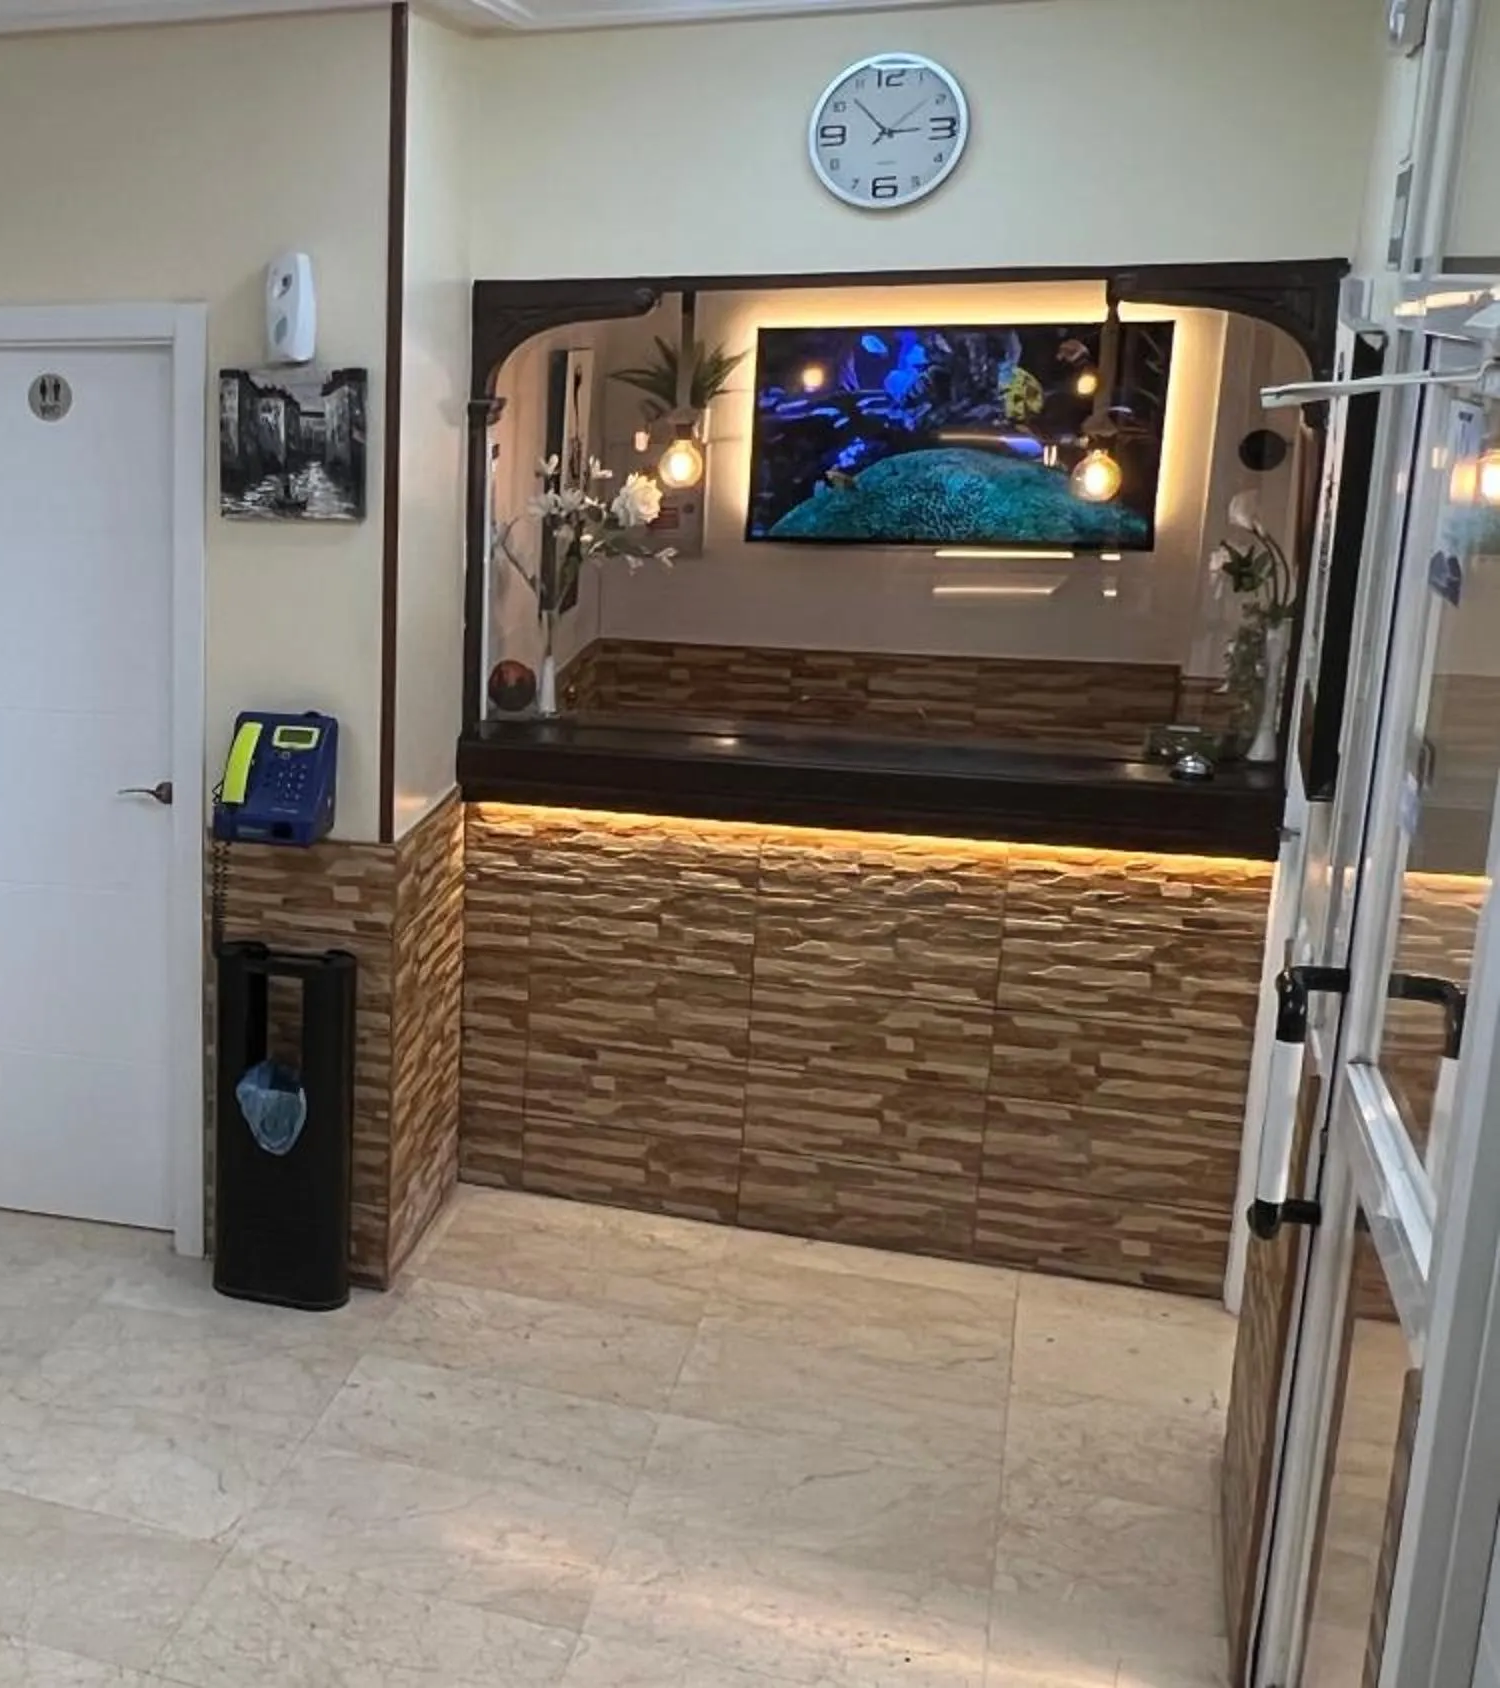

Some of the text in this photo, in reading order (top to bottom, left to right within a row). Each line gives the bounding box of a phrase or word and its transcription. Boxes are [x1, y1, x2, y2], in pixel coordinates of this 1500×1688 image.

[876, 69, 906, 88] 12
[819, 125, 846, 147] 9
[928, 117, 957, 140] 3
[871, 175, 898, 199] 6
